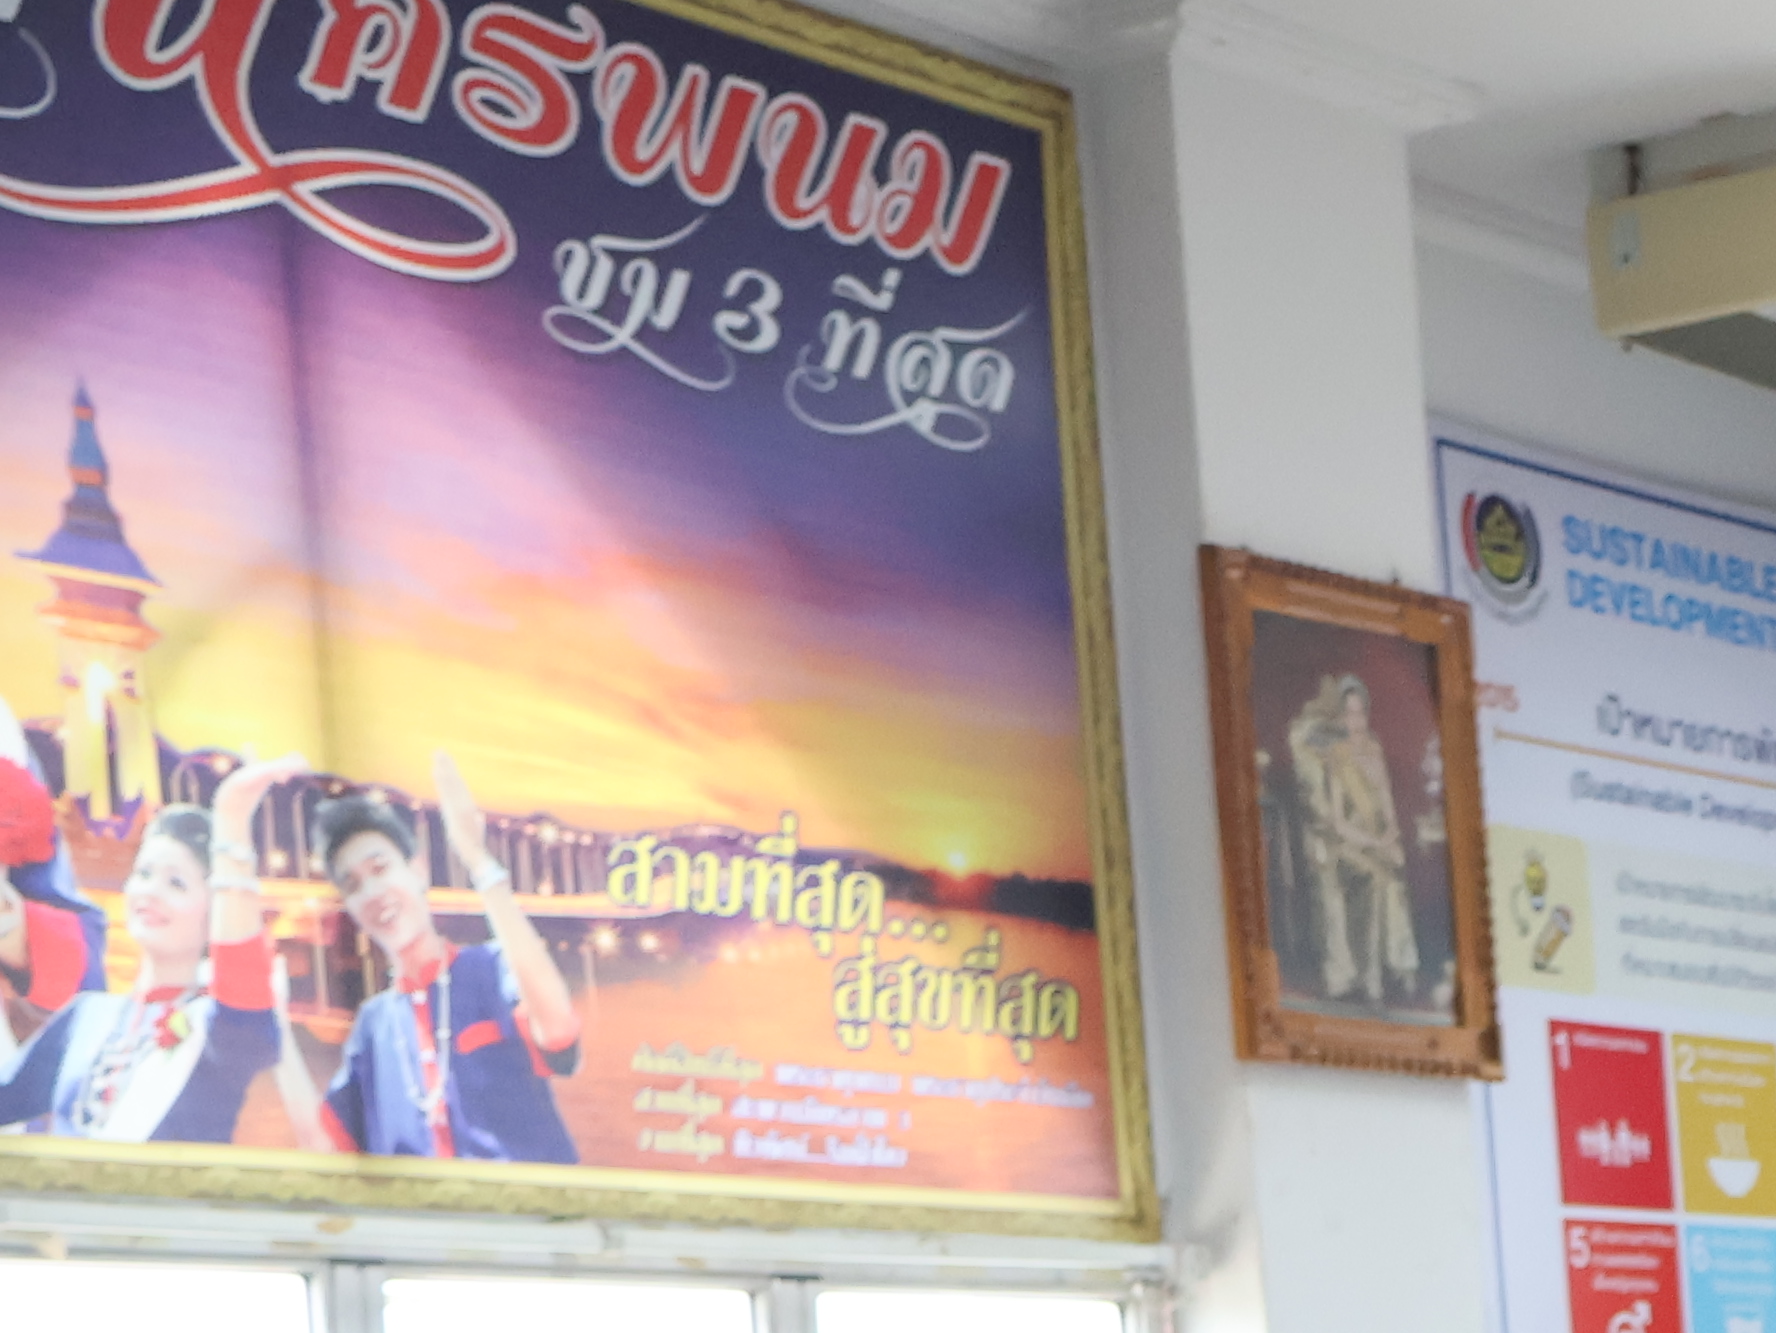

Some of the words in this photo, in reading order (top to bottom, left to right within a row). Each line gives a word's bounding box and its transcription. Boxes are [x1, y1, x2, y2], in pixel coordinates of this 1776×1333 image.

[714, 268, 784, 353] 3
[788, 267, 1026, 446] ที่สุด
[1677, 1044, 1698, 1084] 2
[1568, 1227, 1591, 1268] 5
